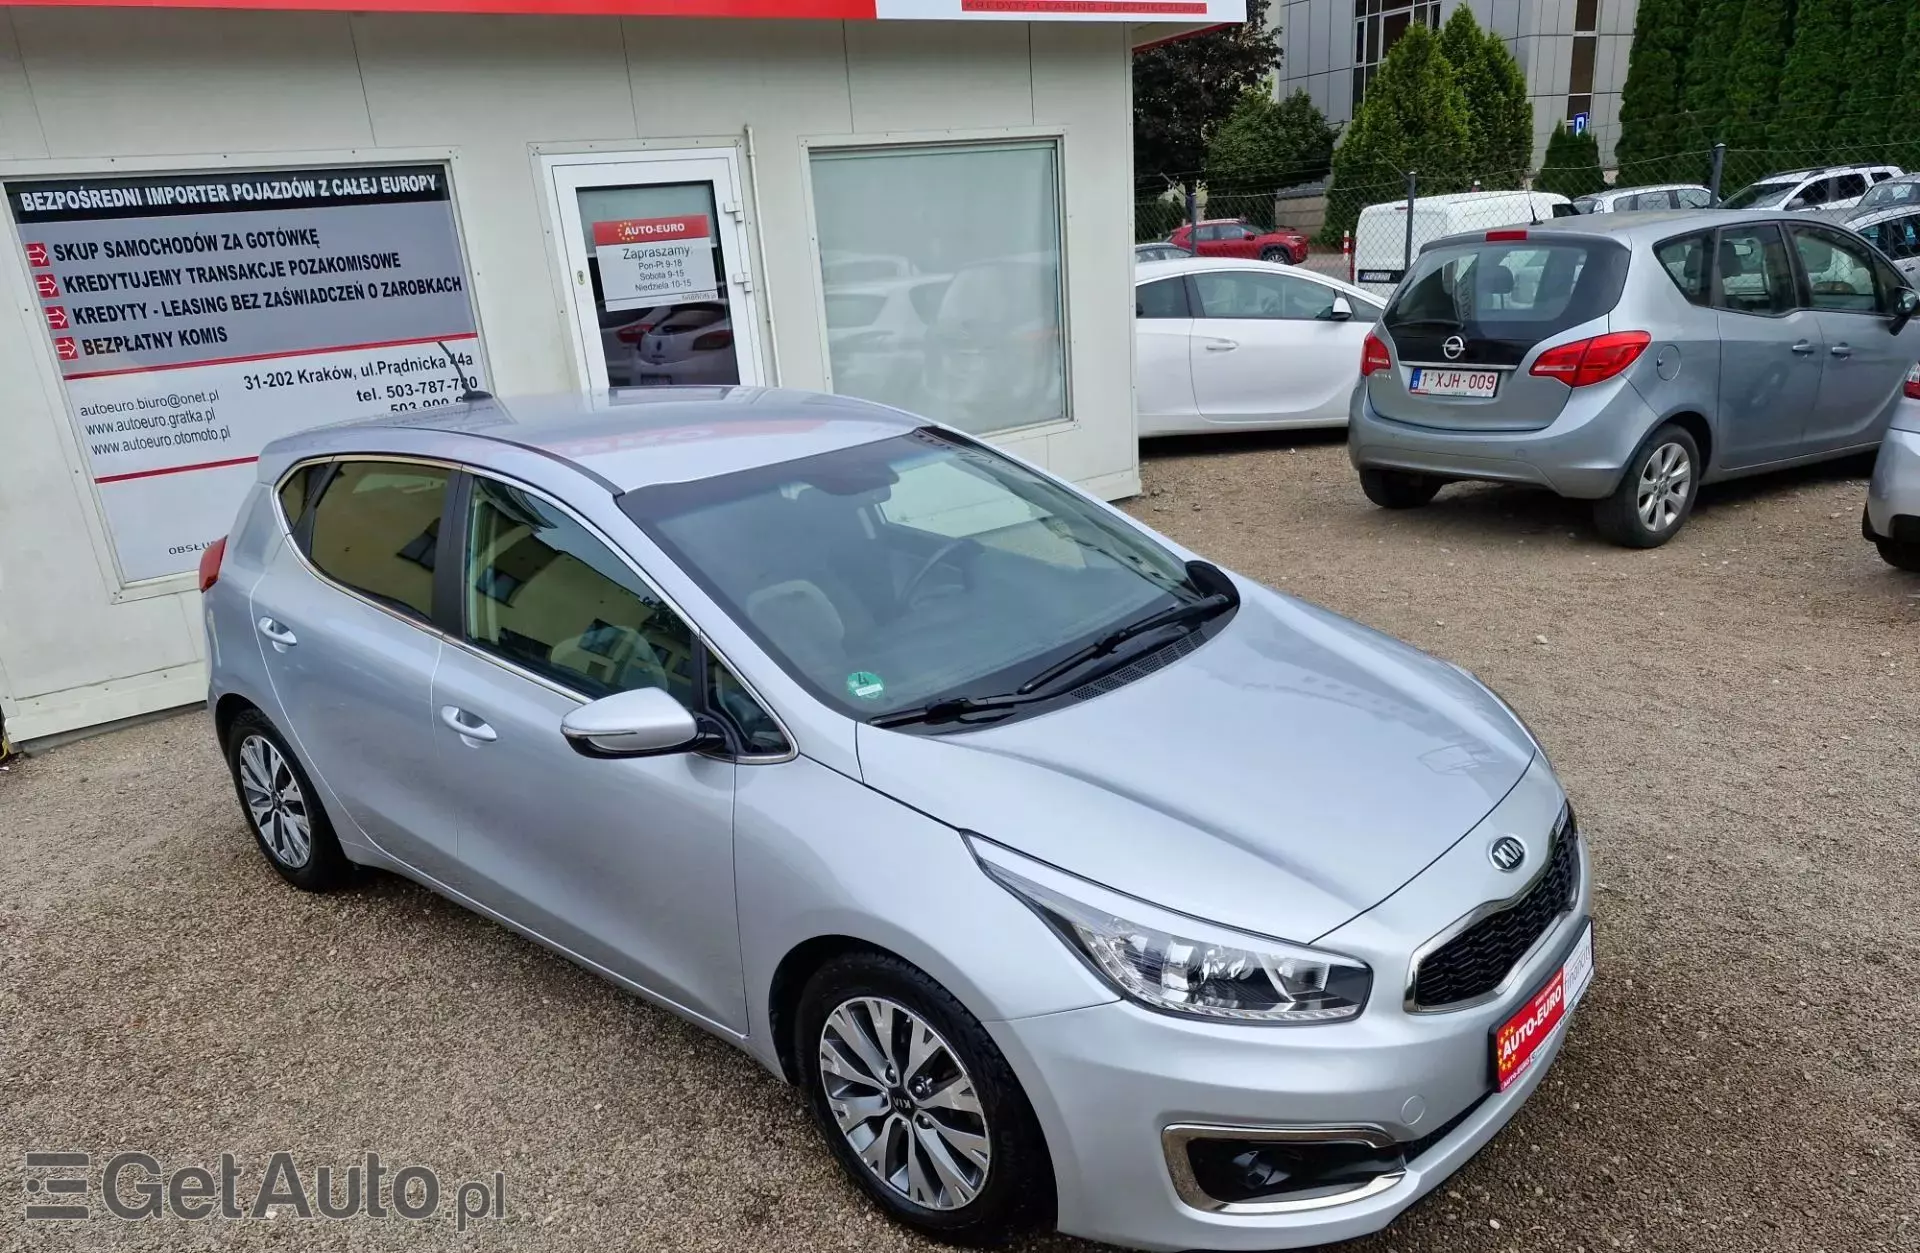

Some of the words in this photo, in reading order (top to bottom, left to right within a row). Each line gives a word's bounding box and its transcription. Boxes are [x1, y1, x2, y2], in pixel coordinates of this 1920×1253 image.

[20, 186, 143, 212] BEZPOŚREDNI
[146, 184, 231, 207] IMPORTER
[232, 177, 316, 202] POJAZDÓW
[319, 179, 330, 198] Z
[332, 177, 377, 197] CAŁEJ
[380, 174, 437, 194] EUROPY
[624, 223, 685, 236] AUTO-EURO
[53, 242, 99, 263] SKUP
[105, 231, 218, 259] SAMOCHODÓW
[221, 233, 244, 251] ZA
[246, 227, 321, 250] GOTÓWKĘ
[63, 268, 182, 294] KREDYTUJEMY
[186, 260, 286, 285] TRANSAKCJE
[289, 252, 401, 276] POZAKOMISOWE
[639, 272, 666, 281] Sobota
[668, 269, 685, 278] 9-15
[665, 258, 683, 268] 9-18
[635, 281, 669, 292] Niedziela
[671, 279, 692, 288] 10-15
[72, 302, 148, 325] KREDYTY
[161, 296, 228, 318] LEASING
[232, 293, 262, 311] BEZ
[263, 281, 365, 308] ZAŚWIADCZEŃ
[368, 283, 379, 299] O
[381, 276, 463, 298] ZAROBKACH
[82, 331, 174, 356] BEZPŁATNY
[178, 326, 228, 347] KOMIS
[244, 370, 295, 391] 31-202
[298, 366, 357, 385] Kraków,
[361, 355, 447, 378] ul.Prądnicka
[80, 389, 220, 417] autoeuro.biuro@onet.pl
[356, 387, 382, 403] tel.
[85, 407, 216, 436] www.autoeuro.gratka.pl
[91, 425, 232, 456] www.autoeuro.otomoto.pl
[168, 541, 218, 555] OBSŁU
[1493, 839, 1524, 867] KIA
[1502, 986, 1562, 1060] AUTO-EURO
